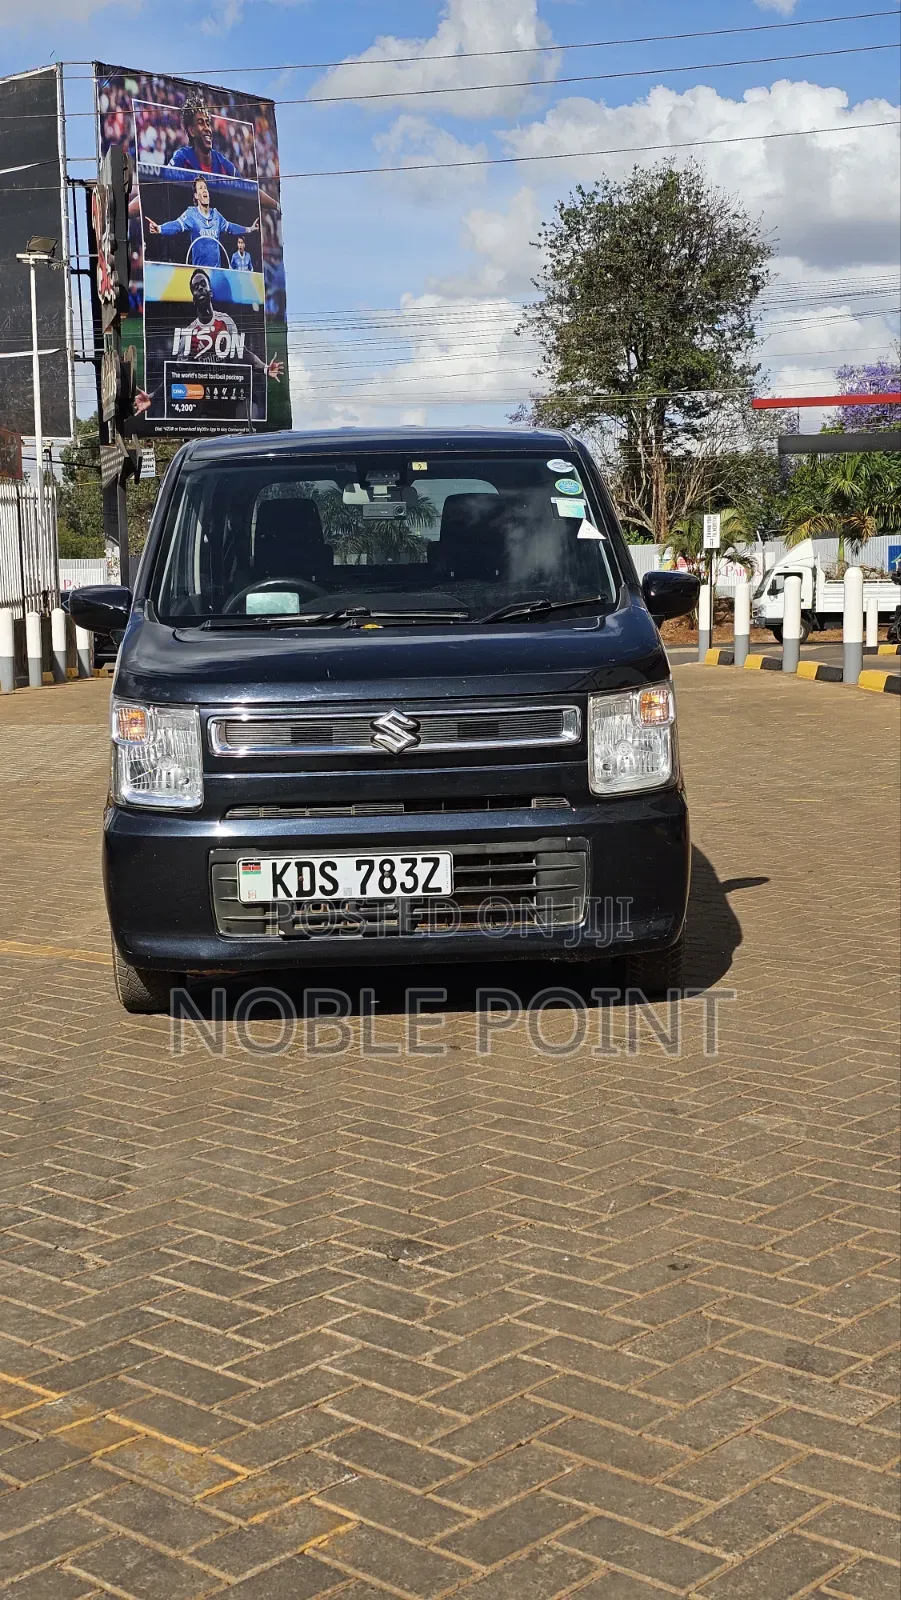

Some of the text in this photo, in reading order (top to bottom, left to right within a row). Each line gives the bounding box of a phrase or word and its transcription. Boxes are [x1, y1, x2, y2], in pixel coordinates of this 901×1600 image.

[172, 327, 245, 359] IT'S ON
[171, 371, 180, 379] The
[271, 861, 339, 898] KDS
[355, 857, 443, 895] 783Z
